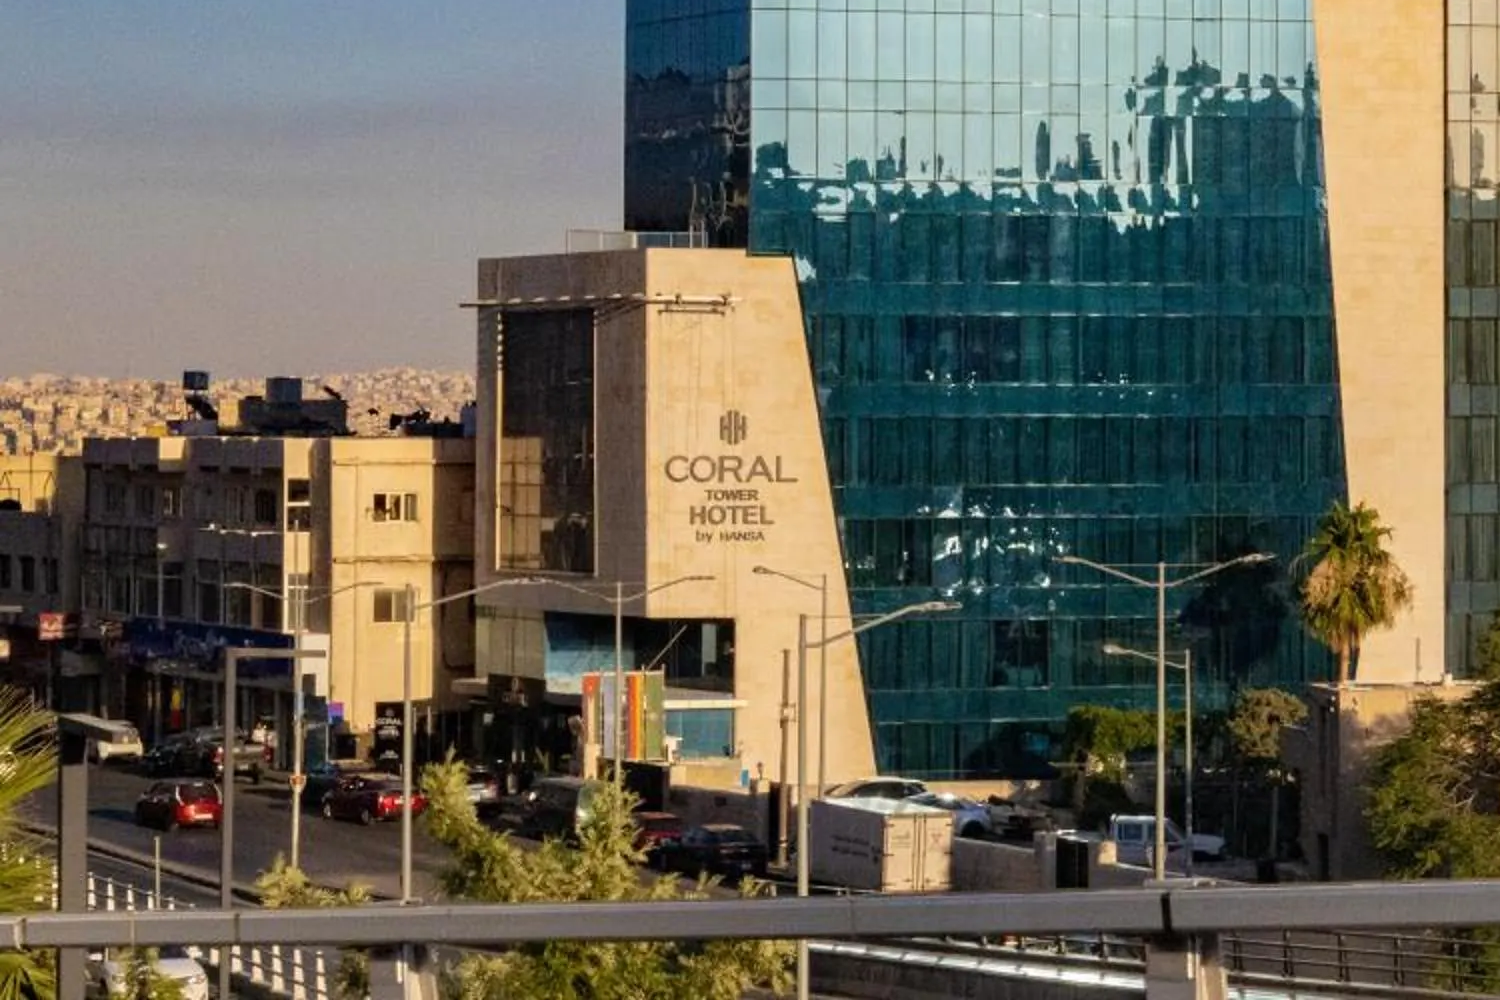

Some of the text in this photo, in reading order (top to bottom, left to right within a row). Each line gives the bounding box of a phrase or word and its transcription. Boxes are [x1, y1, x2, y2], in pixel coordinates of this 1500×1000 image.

[665, 455, 799, 483] CORAL
[704, 489, 760, 501] TOWER
[689, 505, 775, 525] HOTEL
[696, 530, 765, 542] by HANSA
